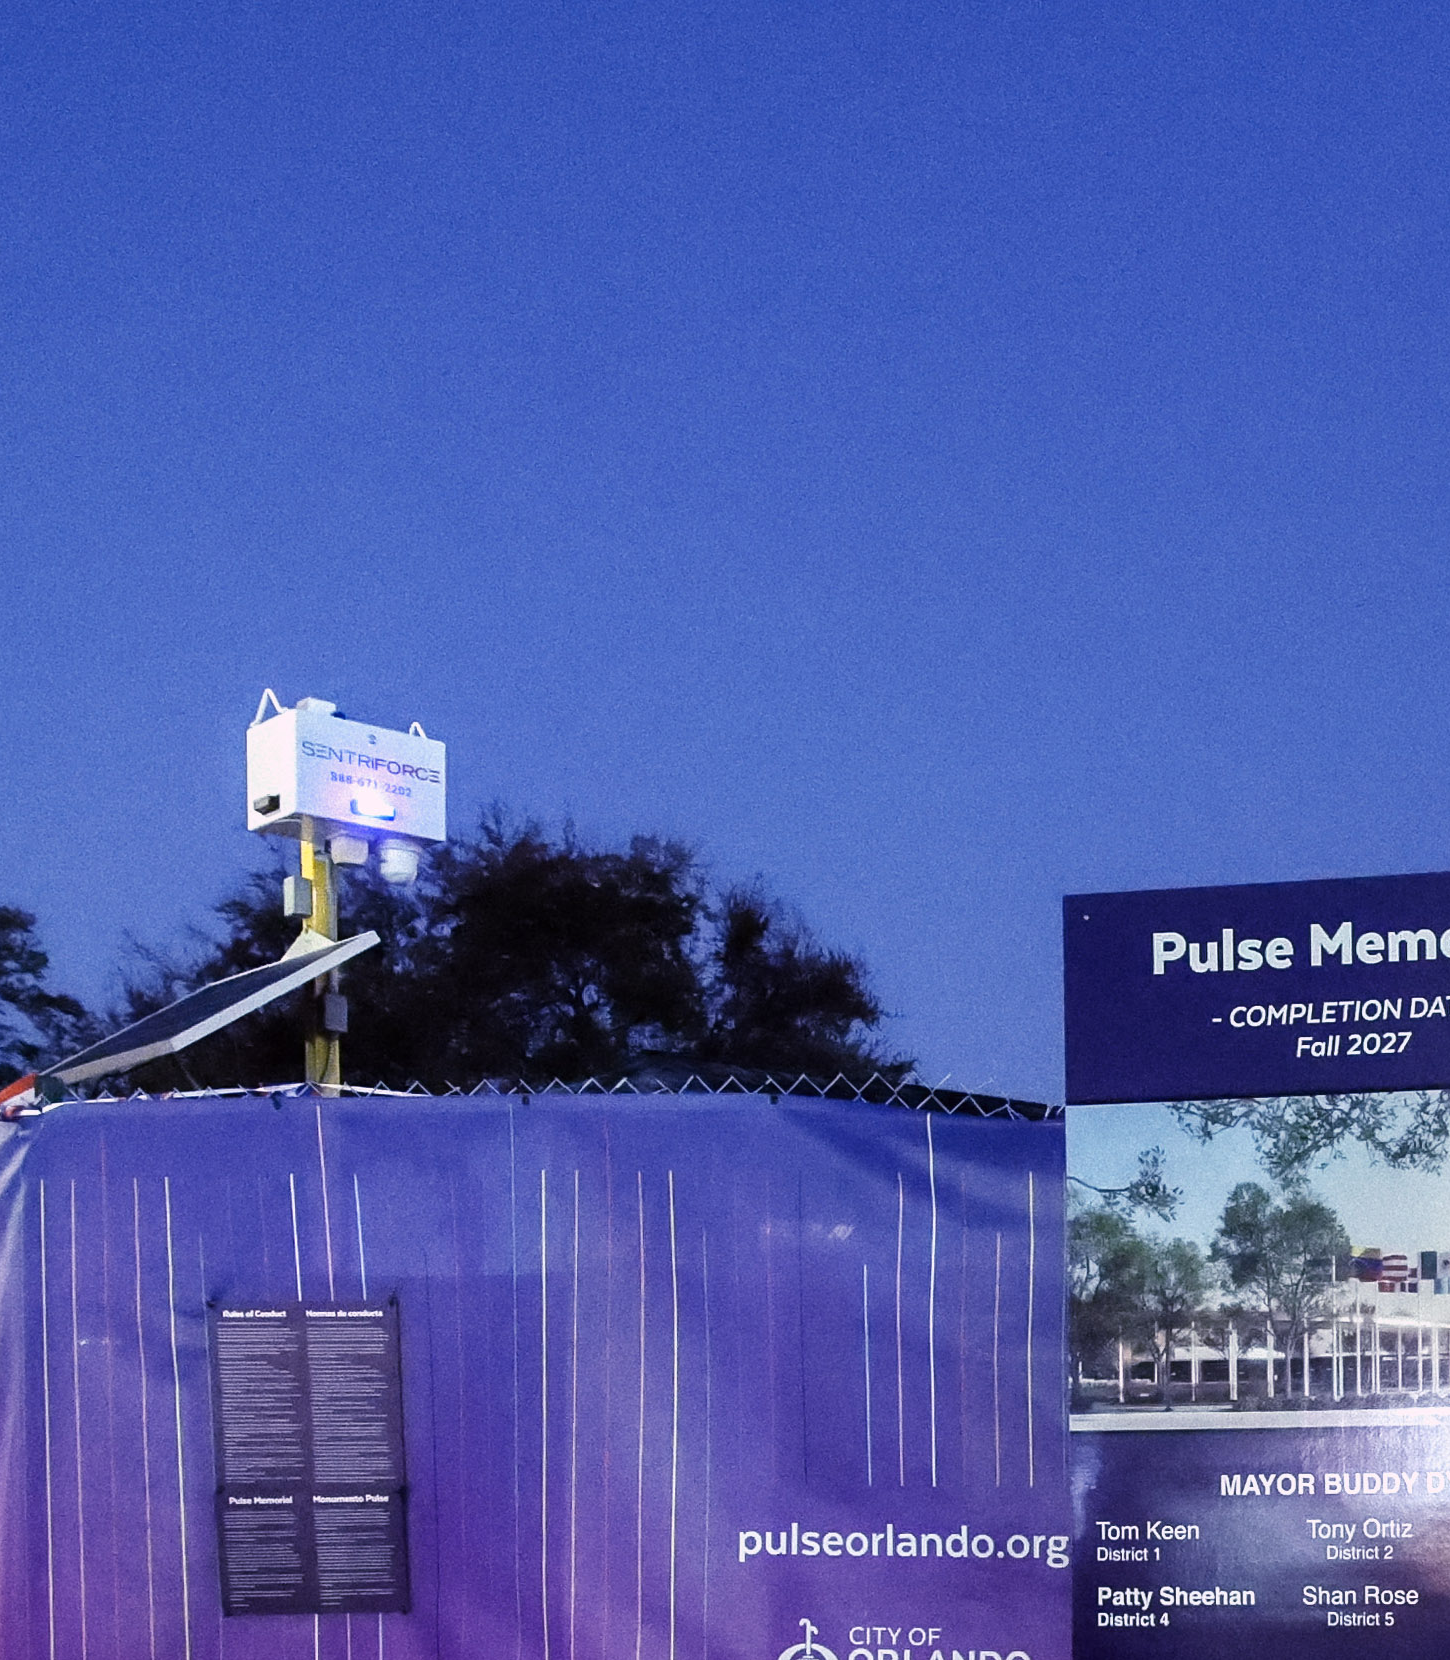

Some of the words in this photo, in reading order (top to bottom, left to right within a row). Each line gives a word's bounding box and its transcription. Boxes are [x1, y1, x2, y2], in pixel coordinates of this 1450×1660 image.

[302, 741, 440, 784] SENTRIFORCE
[1153, 929, 1293, 974] Pulse
[1230, 998, 1402, 1027] COMPLETION
[1297, 1035, 1340, 1057] Fall
[1347, 1032, 1412, 1055] 2027
[1221, 1473, 1315, 1496] MAYOR
[1324, 1472, 1420, 1495] BUDDY
[1096, 1522, 1139, 1540] Tom
[1147, 1521, 1199, 1540] Keen
[1307, 1520, 1361, 1543] Tony
[1365, 1518, 1413, 1540] Ortiz
[739, 1523, 1069, 1568] pulseorlando.org
[1097, 1547, 1148, 1561] District
[1152, 1547, 1160, 1561] 1
[1327, 1545, 1379, 1559] District
[1384, 1545, 1393, 1559] 2
[1099, 1587, 1153, 1610] Patty
[1160, 1587, 1255, 1605] Sheehan
[1303, 1586, 1356, 1605] Shan
[1365, 1586, 1418, 1604] Rose
[1098, 1613, 1153, 1626] District
[1160, 1613, 1169, 1626] 4
[1328, 1612, 1380, 1626] District
[1385, 1612, 1394, 1626] 5
[850, 1627, 901, 1644] CITY
[909, 1628, 941, 1645] OF
